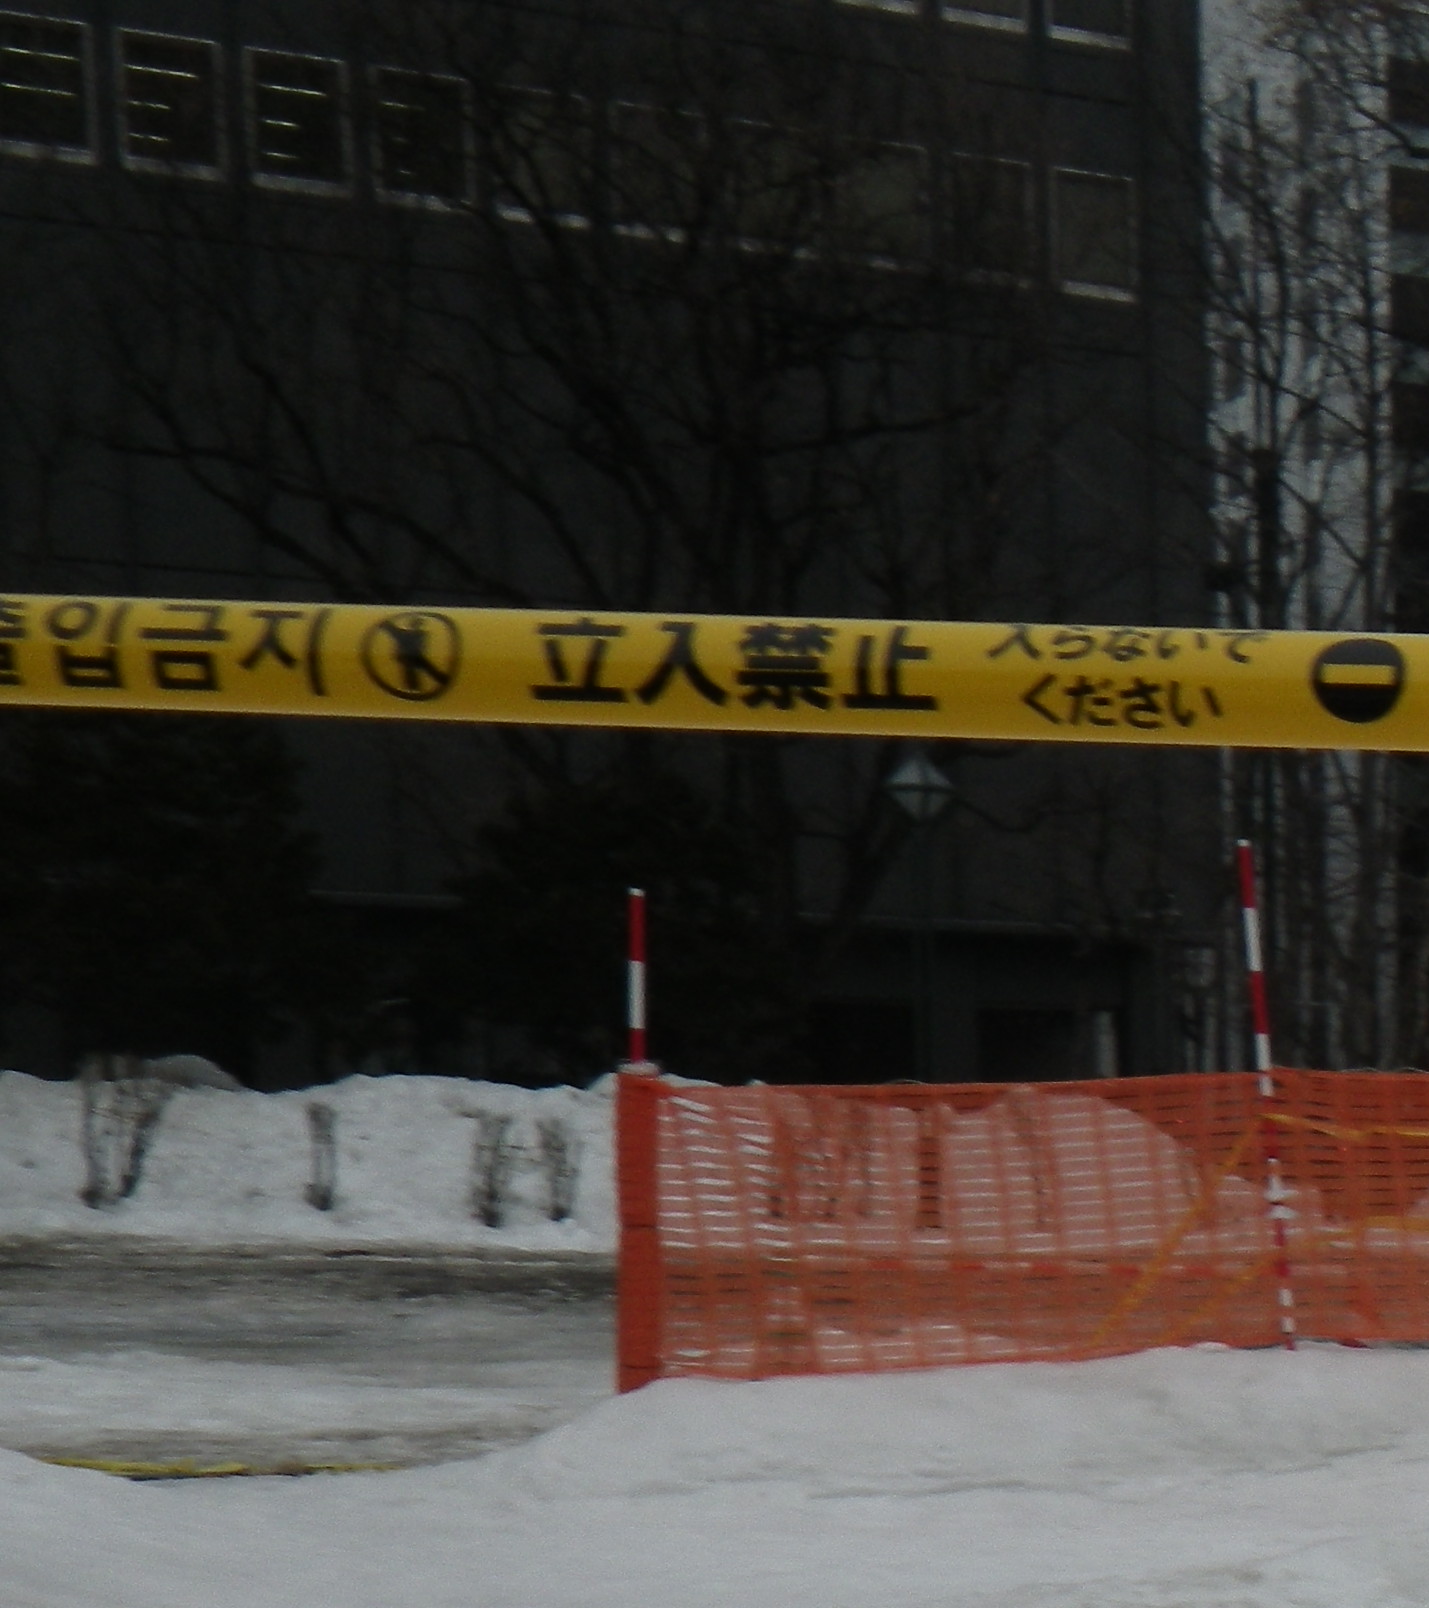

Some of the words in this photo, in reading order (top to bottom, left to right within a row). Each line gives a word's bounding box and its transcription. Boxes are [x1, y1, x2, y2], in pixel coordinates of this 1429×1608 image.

[530, 617, 939, 711] 立入禁止
[1020, 673, 1224, 729] ください
